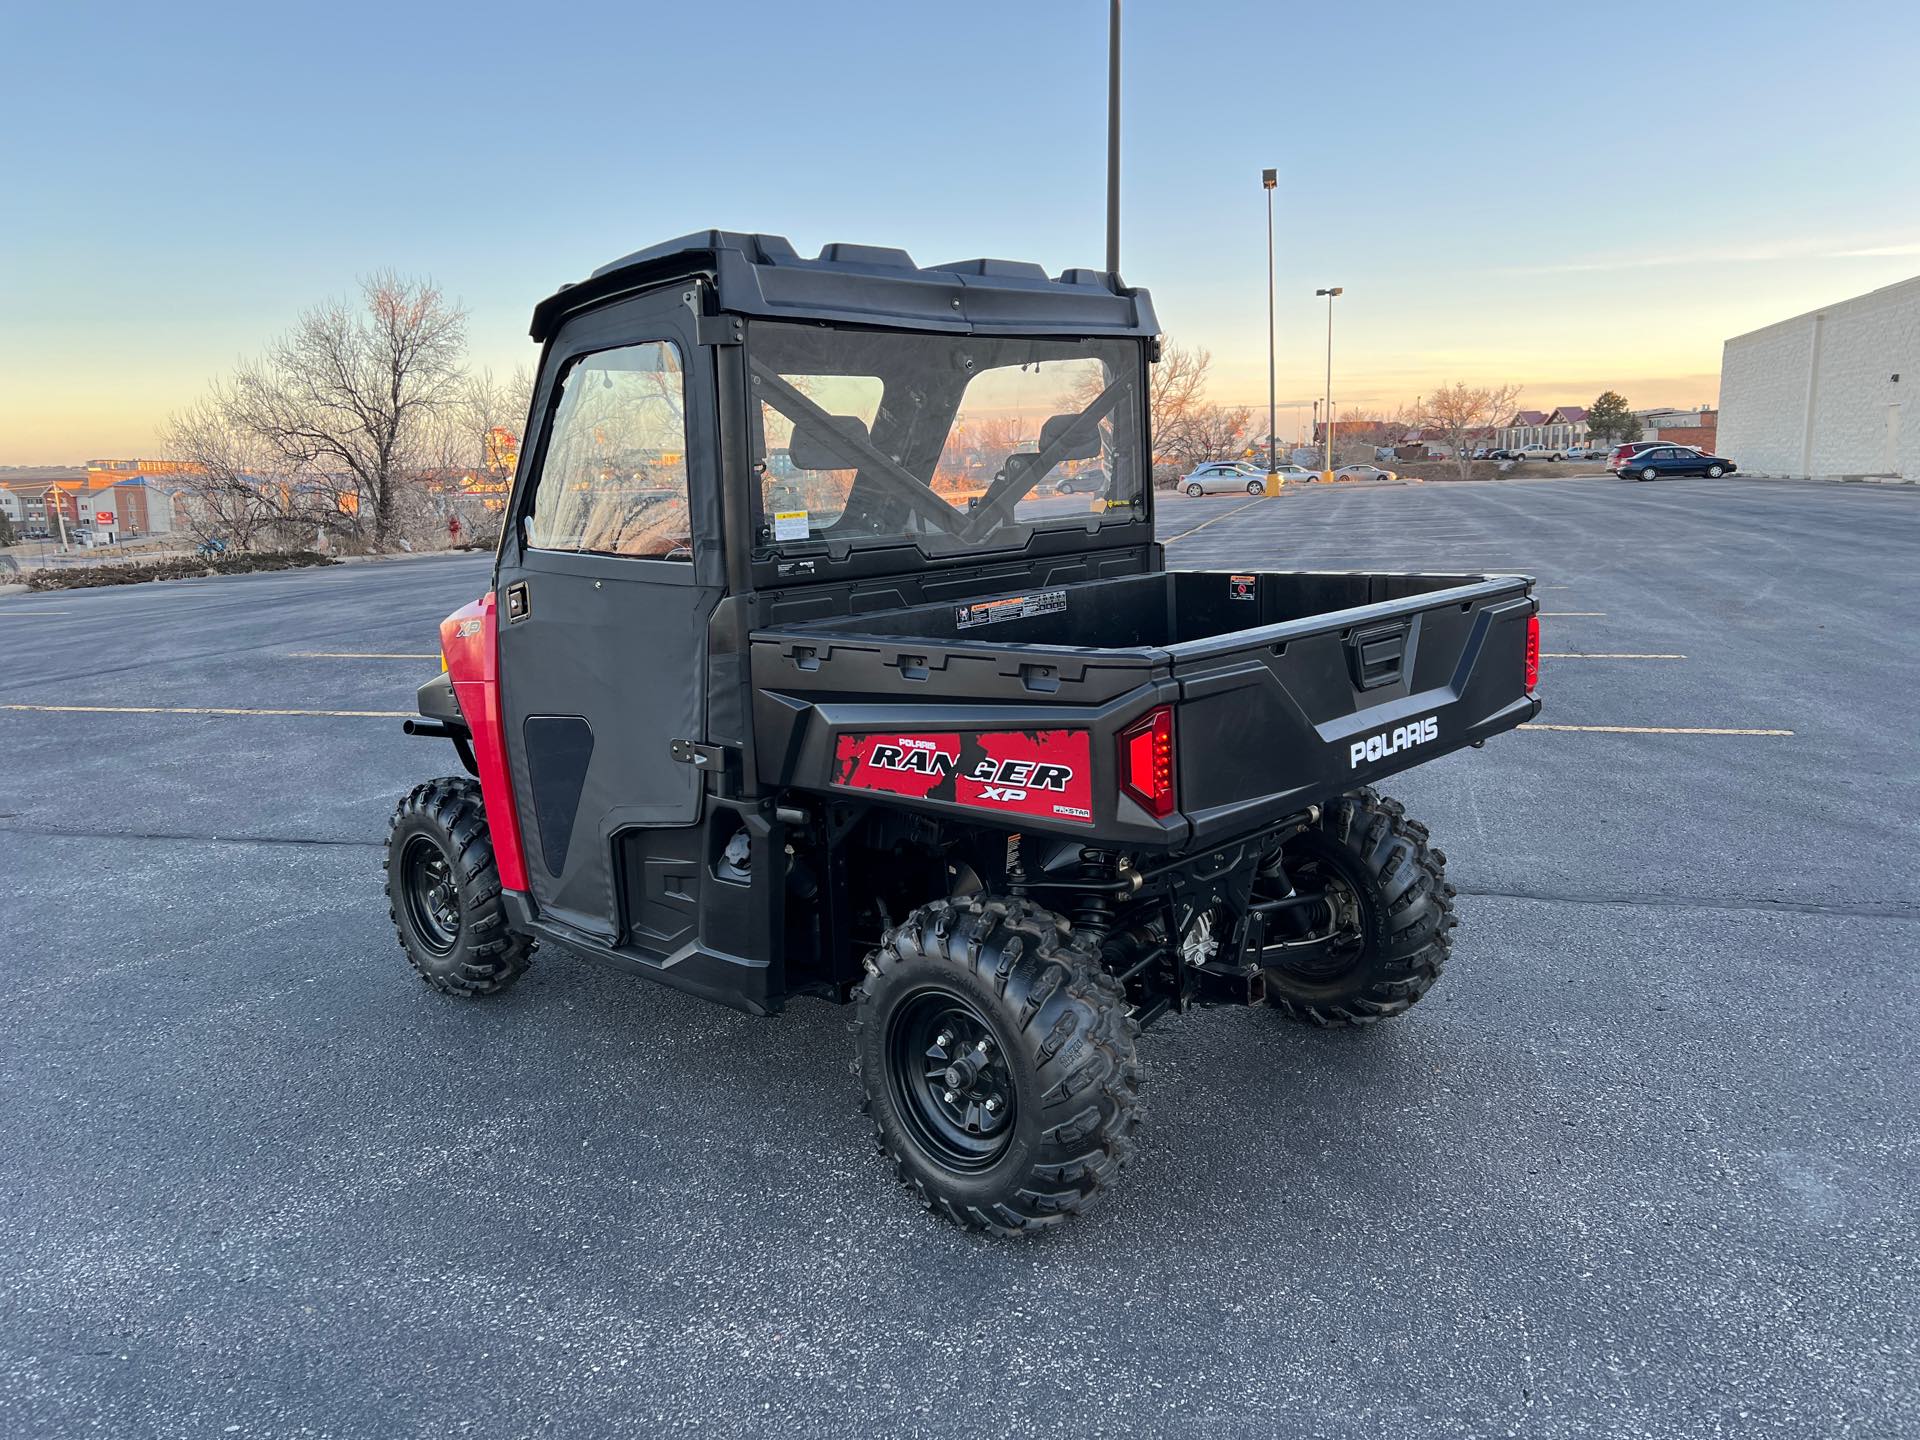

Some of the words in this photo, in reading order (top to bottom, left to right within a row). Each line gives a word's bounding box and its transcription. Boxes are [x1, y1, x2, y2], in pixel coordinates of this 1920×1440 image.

[456, 621, 481, 638] XP
[898, 738, 936, 750] POLARIS
[1350, 716, 1438, 769] POLARIS
[868, 743, 1073, 792] RANGER
[977, 785, 1028, 802] XP
